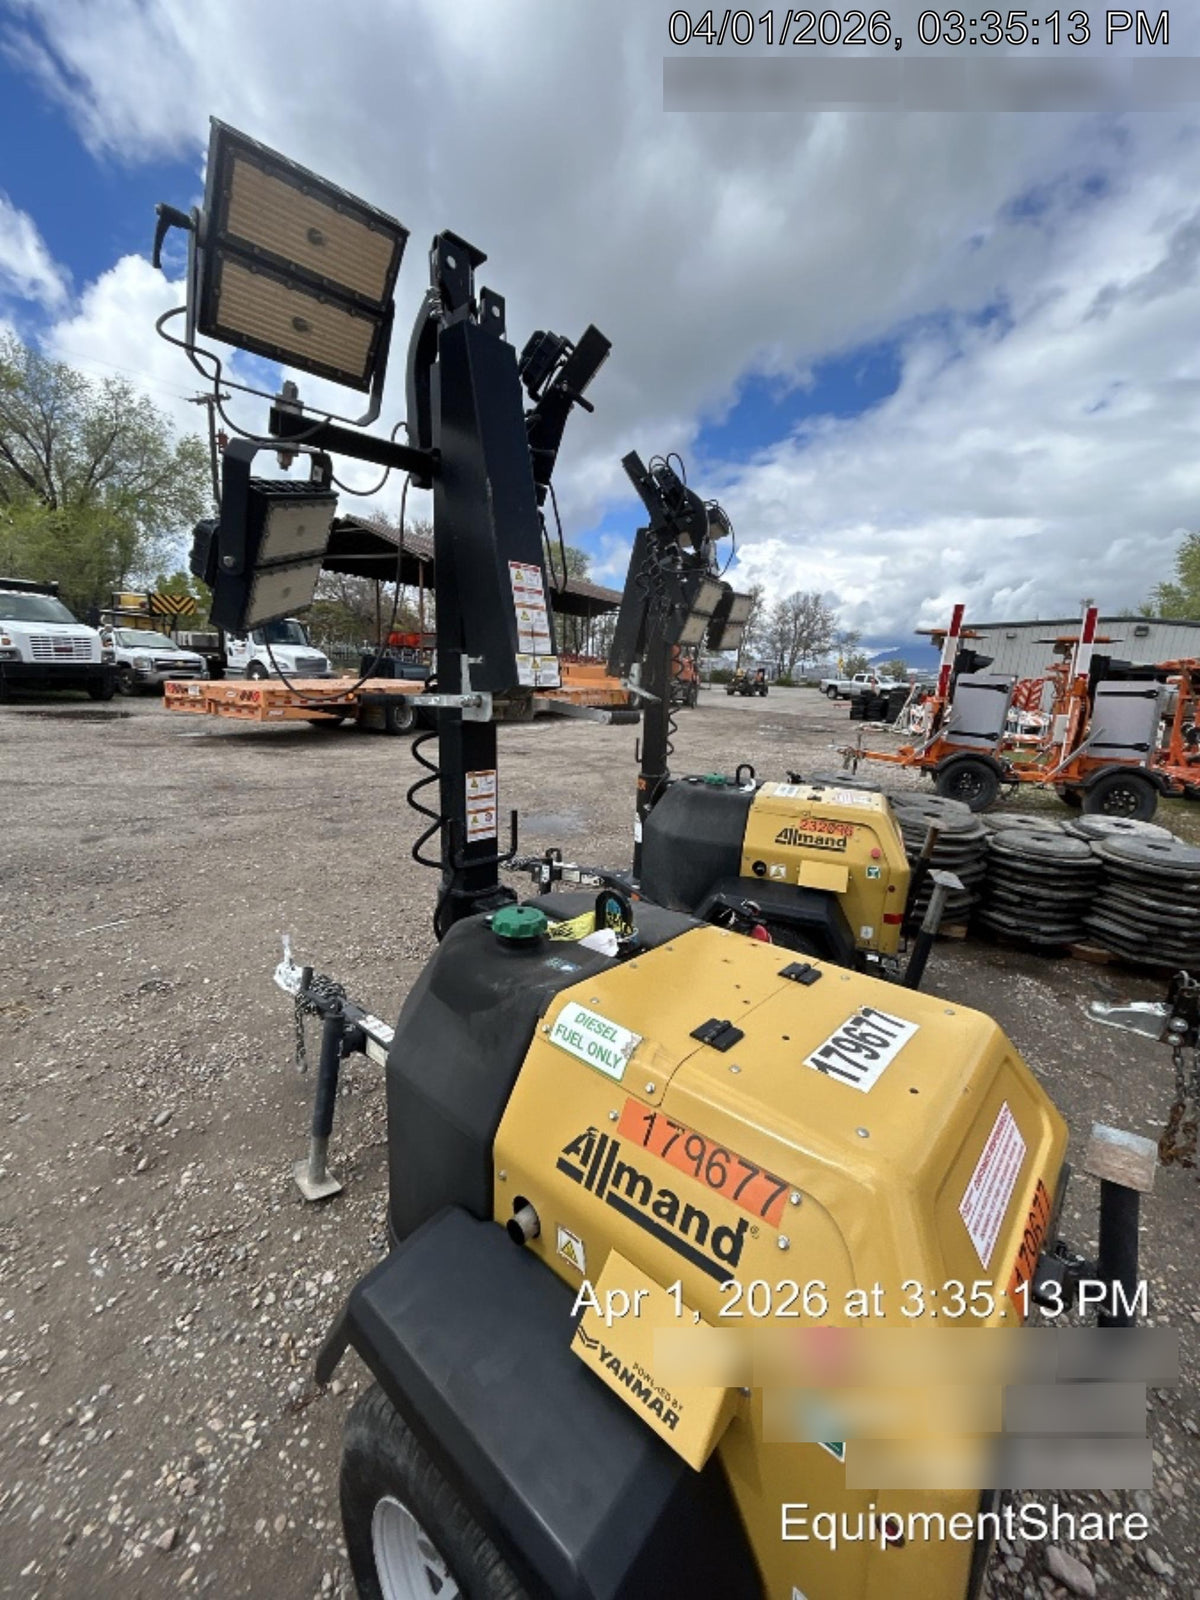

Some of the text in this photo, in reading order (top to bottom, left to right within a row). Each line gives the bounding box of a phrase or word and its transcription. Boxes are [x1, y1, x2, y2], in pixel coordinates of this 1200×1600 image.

[775, 828, 847, 850] Allmand
[554, 1023, 623, 1069] FUEL ONLY
[574, 1012, 618, 1043] DIESEL
[810, 1007, 906, 1083] 179677
[561, 1127, 749, 1269] Allmand
[642, 1112, 790, 1218] 179677
[599, 1344, 680, 1431] YANMAR
